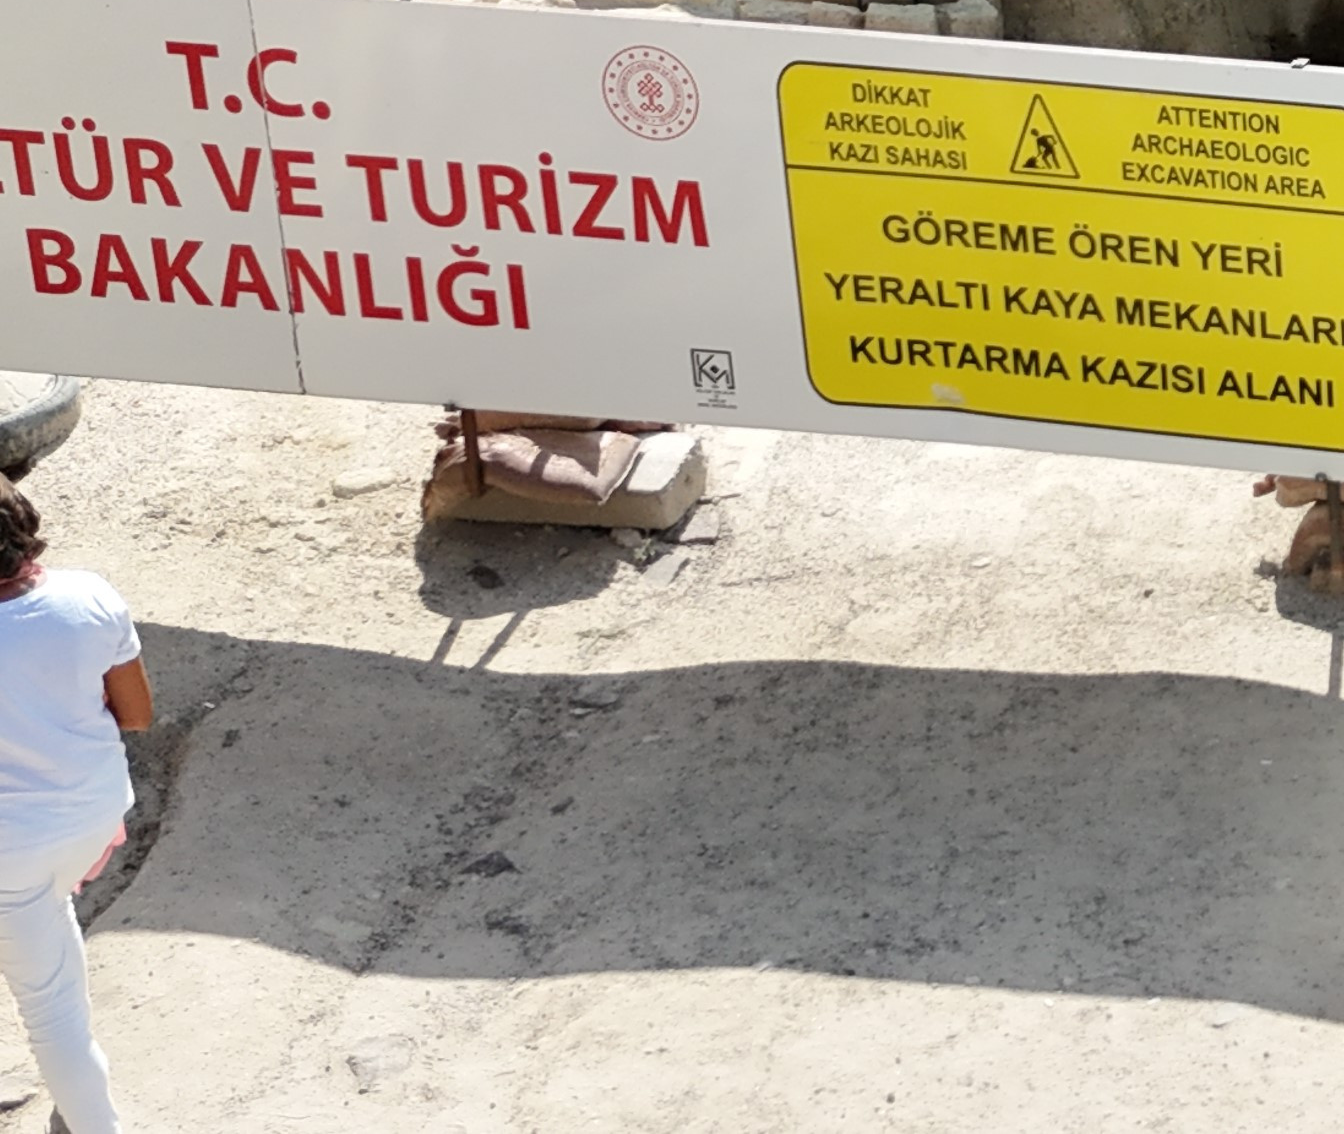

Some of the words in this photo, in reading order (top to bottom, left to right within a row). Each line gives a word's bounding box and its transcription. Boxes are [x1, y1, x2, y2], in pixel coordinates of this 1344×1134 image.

[166, 41, 330, 120] T.C.
[851, 79, 931, 109] DİKKAT
[824, 111, 967, 142] ARKEOLOJİK
[1157, 105, 1281, 135] ATTENTION
[829, 141, 879, 165] KAZI
[885, 145, 967, 170] SAHASI
[1131, 133, 1311, 168] ARCHAEOLOGIC
[0, 117, 180, 207] TÜR
[203, 143, 323, 218] VE
[346, 152, 709, 248] TURİZM
[1121, 161, 1258, 193] EXCAVATION
[1265, 175, 1326, 200] AREA
[882, 209, 1056, 256] GÖREME
[1068, 222, 1180, 268] ÖREN
[1191, 240, 1284, 278] YERİ
[26, 228, 529, 330] BAKANLIĞI
[823, 272, 990, 311] YERALTI
[1003, 285, 1105, 322] KAYA
[849, 335, 1071, 381] KURTARMA
[1081, 355, 1206, 395] KAZISI
[1216, 369, 1335, 408] ALANI
